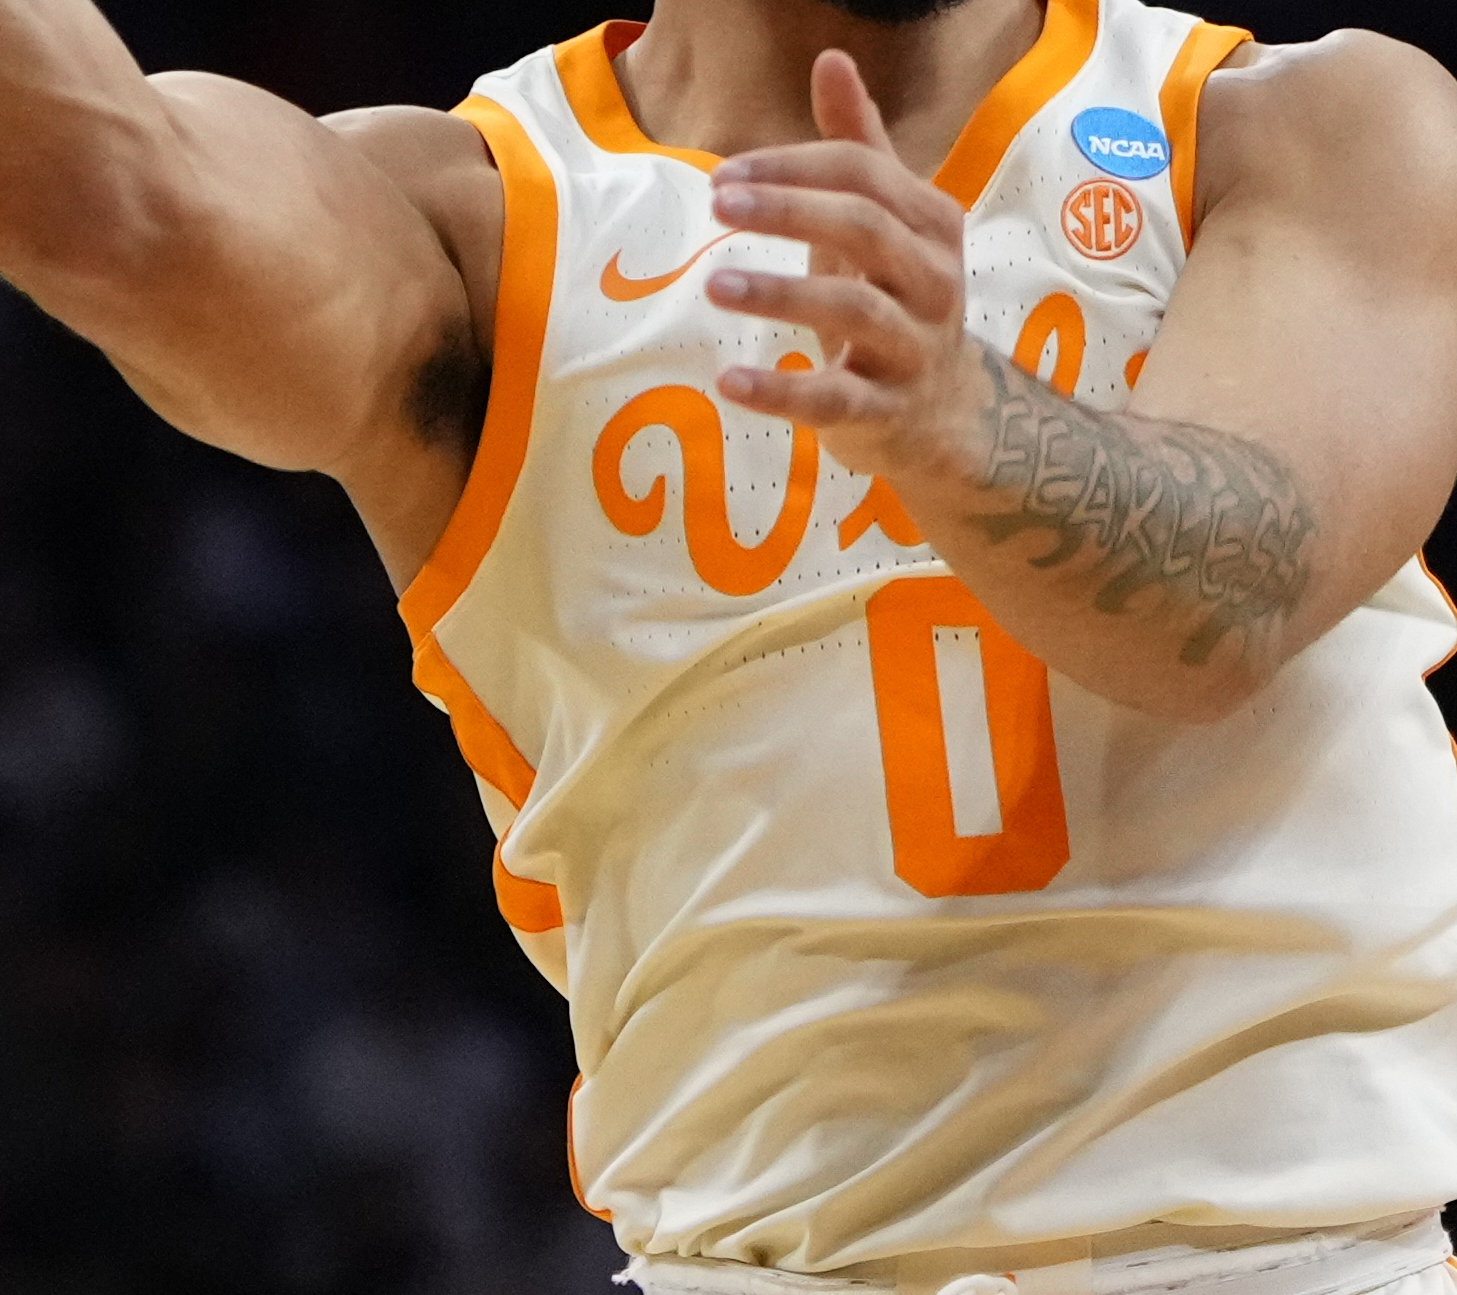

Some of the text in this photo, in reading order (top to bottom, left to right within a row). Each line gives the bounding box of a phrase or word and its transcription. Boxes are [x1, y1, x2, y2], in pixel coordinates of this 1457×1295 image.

[1088, 135, 1166, 161] NCAA
[1068, 184, 1135, 252] SEC
[865, 575, 1071, 899] 0
